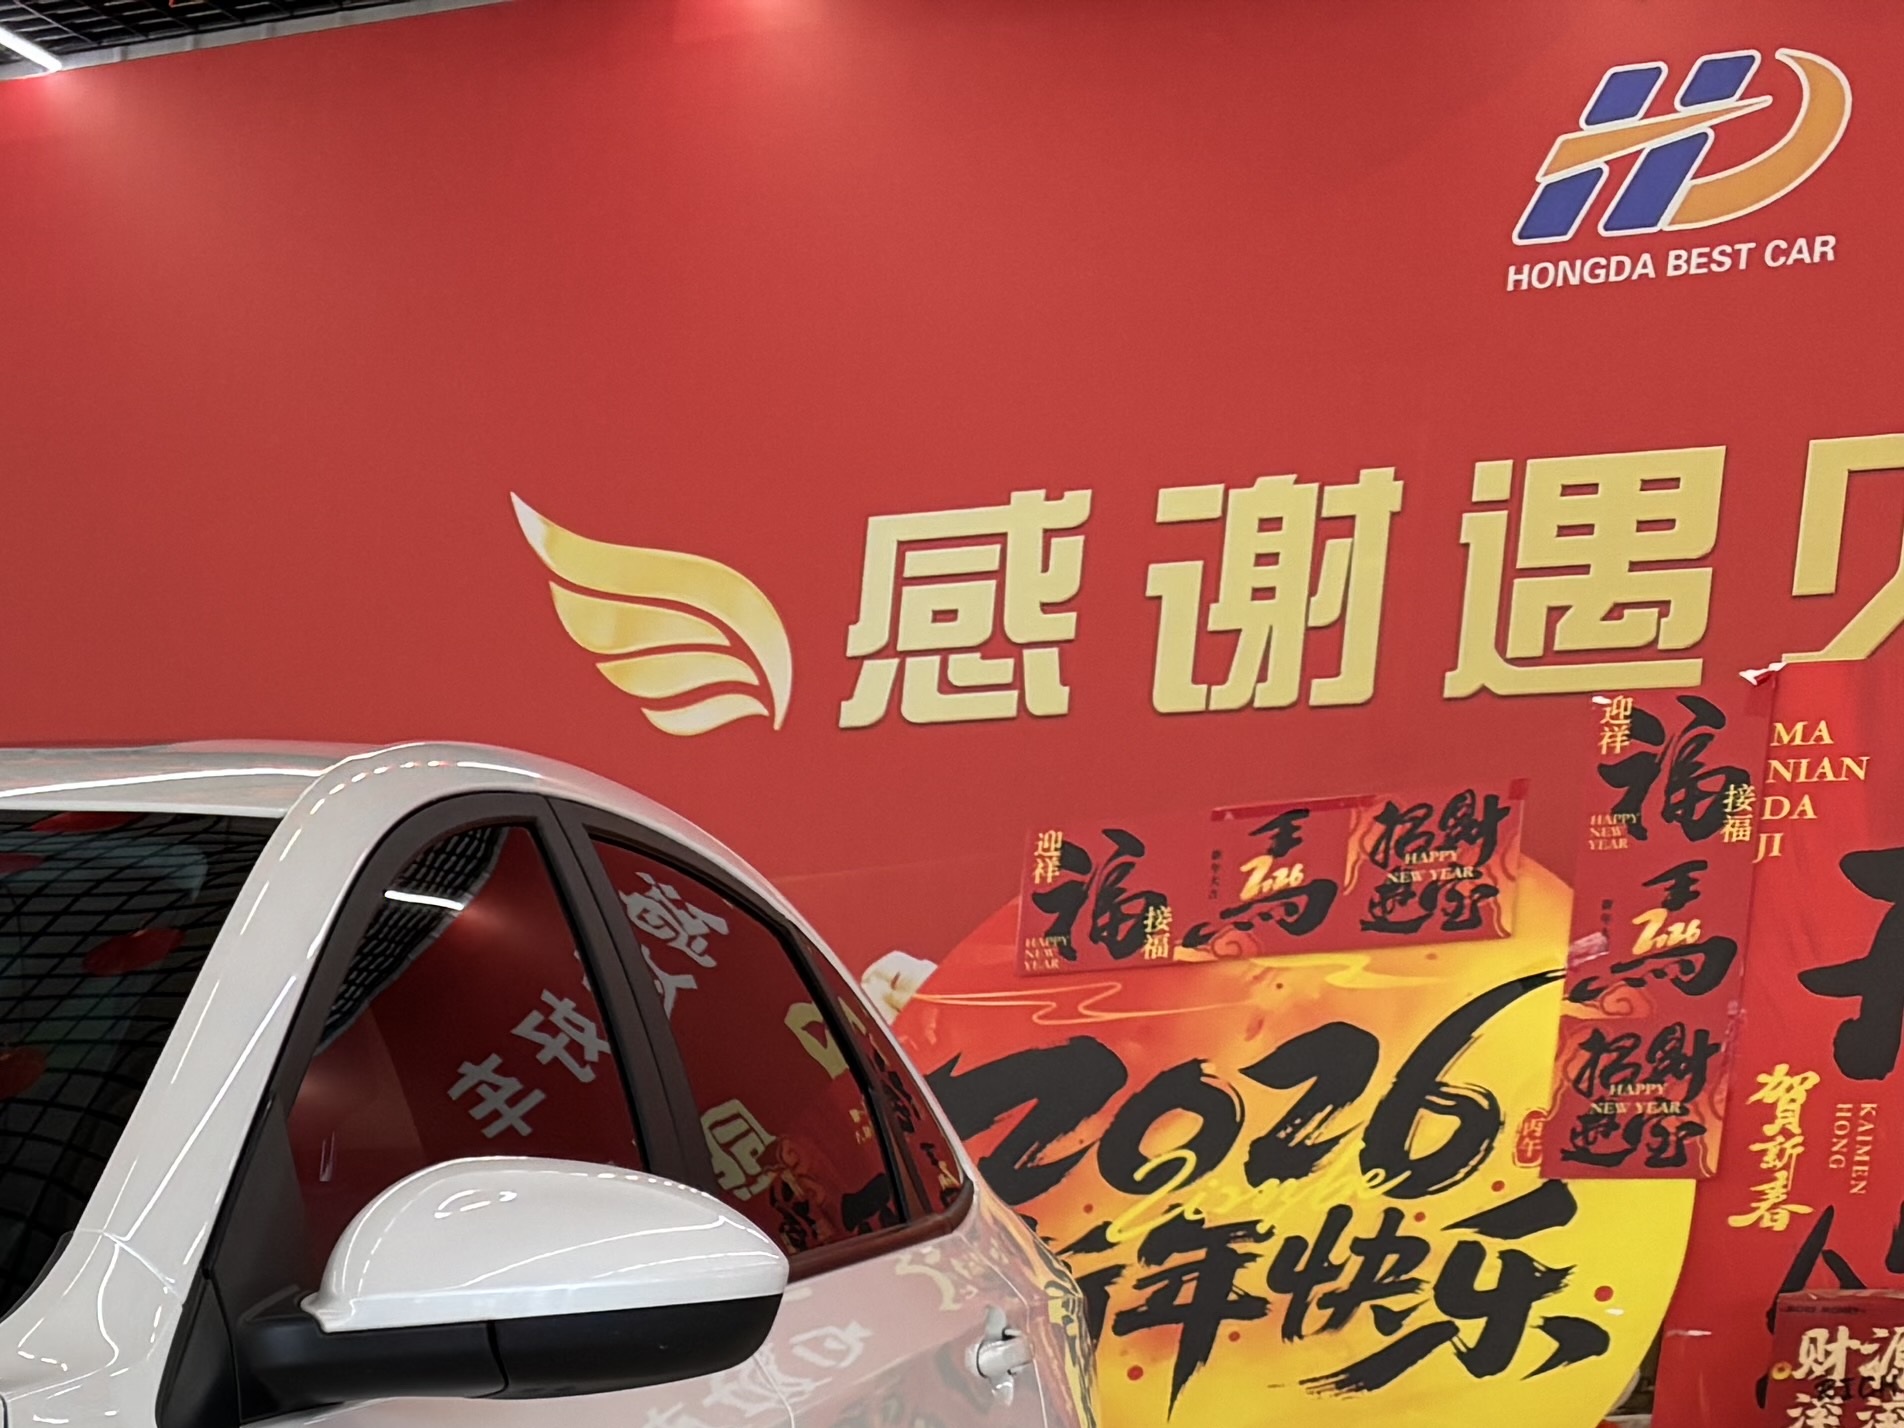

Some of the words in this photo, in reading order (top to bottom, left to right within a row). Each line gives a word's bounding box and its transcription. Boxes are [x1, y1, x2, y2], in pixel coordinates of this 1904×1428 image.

[1506, 253, 1656, 291] HONGDA
[1666, 242, 1756, 277] BEST
[1764, 235, 1836, 267] CAR
[1770, 720, 1834, 746] MA
[1766, 757, 1870, 784] NIAN
[1720, 784, 1756, 842] 接福
[1761, 794, 1817, 821] DA
[1404, 849, 1458, 865] HAPPY
[1589, 839, 1628, 850] YEAR
[1753, 833, 1784, 864] JI
[1387, 869, 1428, 885] NEW
[1429, 865, 1475, 882] YEAR
[1143, 905, 1173, 960] 接福
[925, 968, 1566, 1205] 2026
[1609, 1083, 1668, 1097] HAPPY
[1589, 1101, 1634, 1116] NEW
[1636, 1100, 1682, 1116] YEAR
[1828, 1102, 1853, 1171] HONG
[1850, 1102, 1878, 1197] KAIMEN
